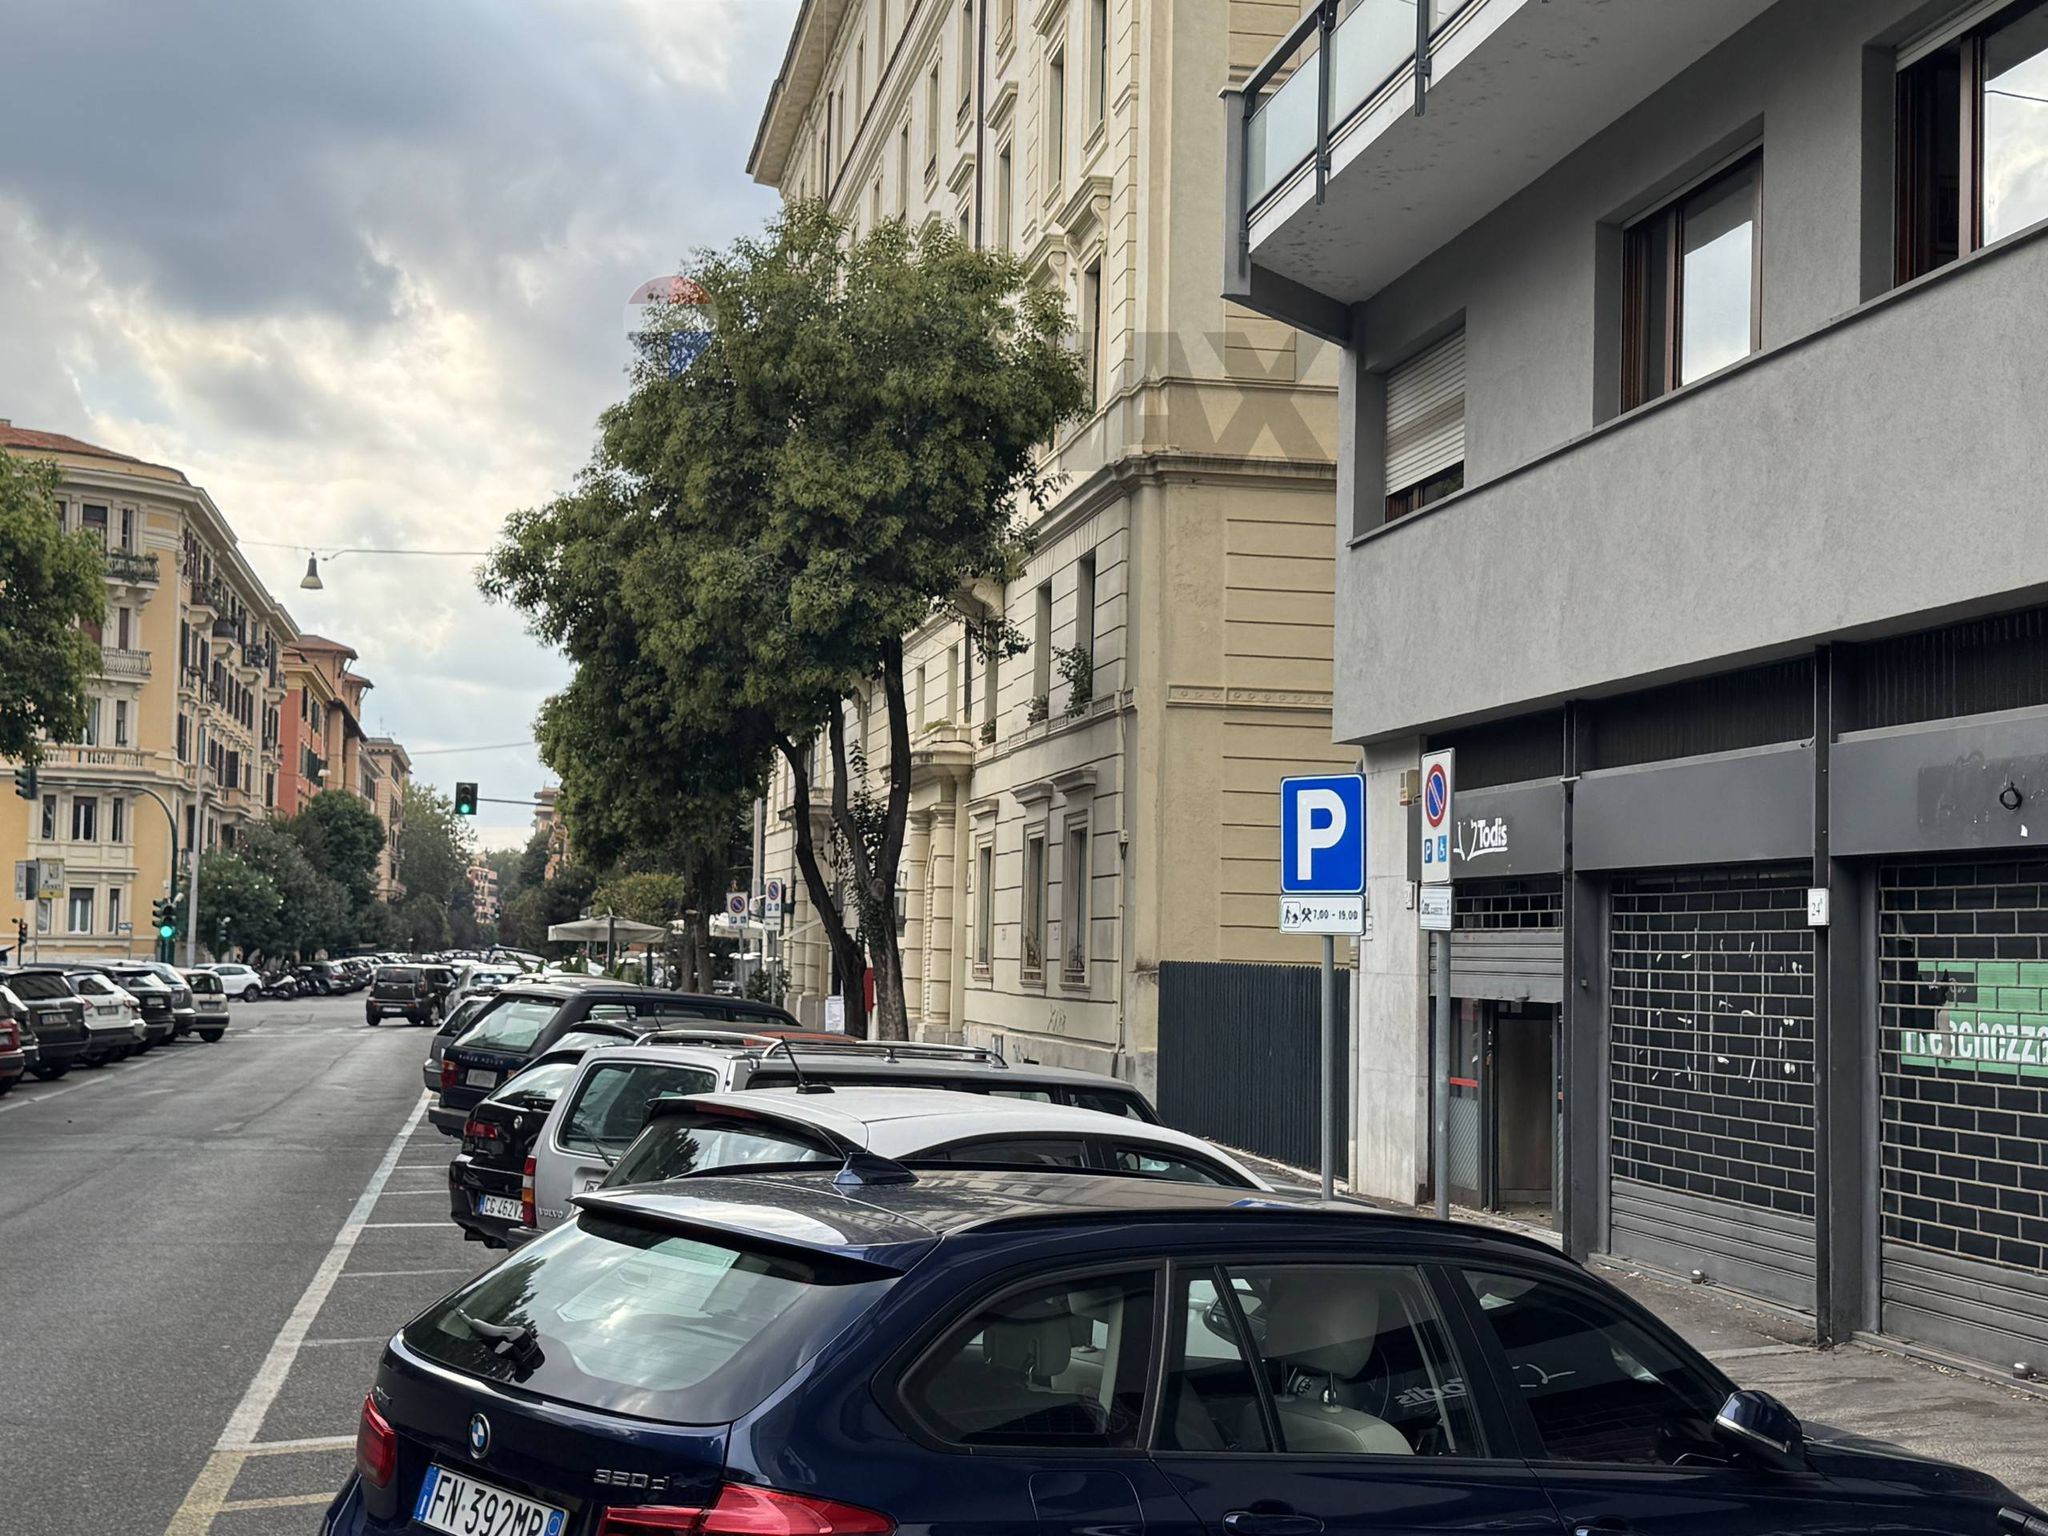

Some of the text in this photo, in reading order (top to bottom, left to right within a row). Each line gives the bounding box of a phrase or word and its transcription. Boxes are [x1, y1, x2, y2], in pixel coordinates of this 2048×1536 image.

[1297, 789, 1346, 880] P
[1477, 817, 1508, 848] Todis
[538, 1206, 564, 1219] VOLVO
